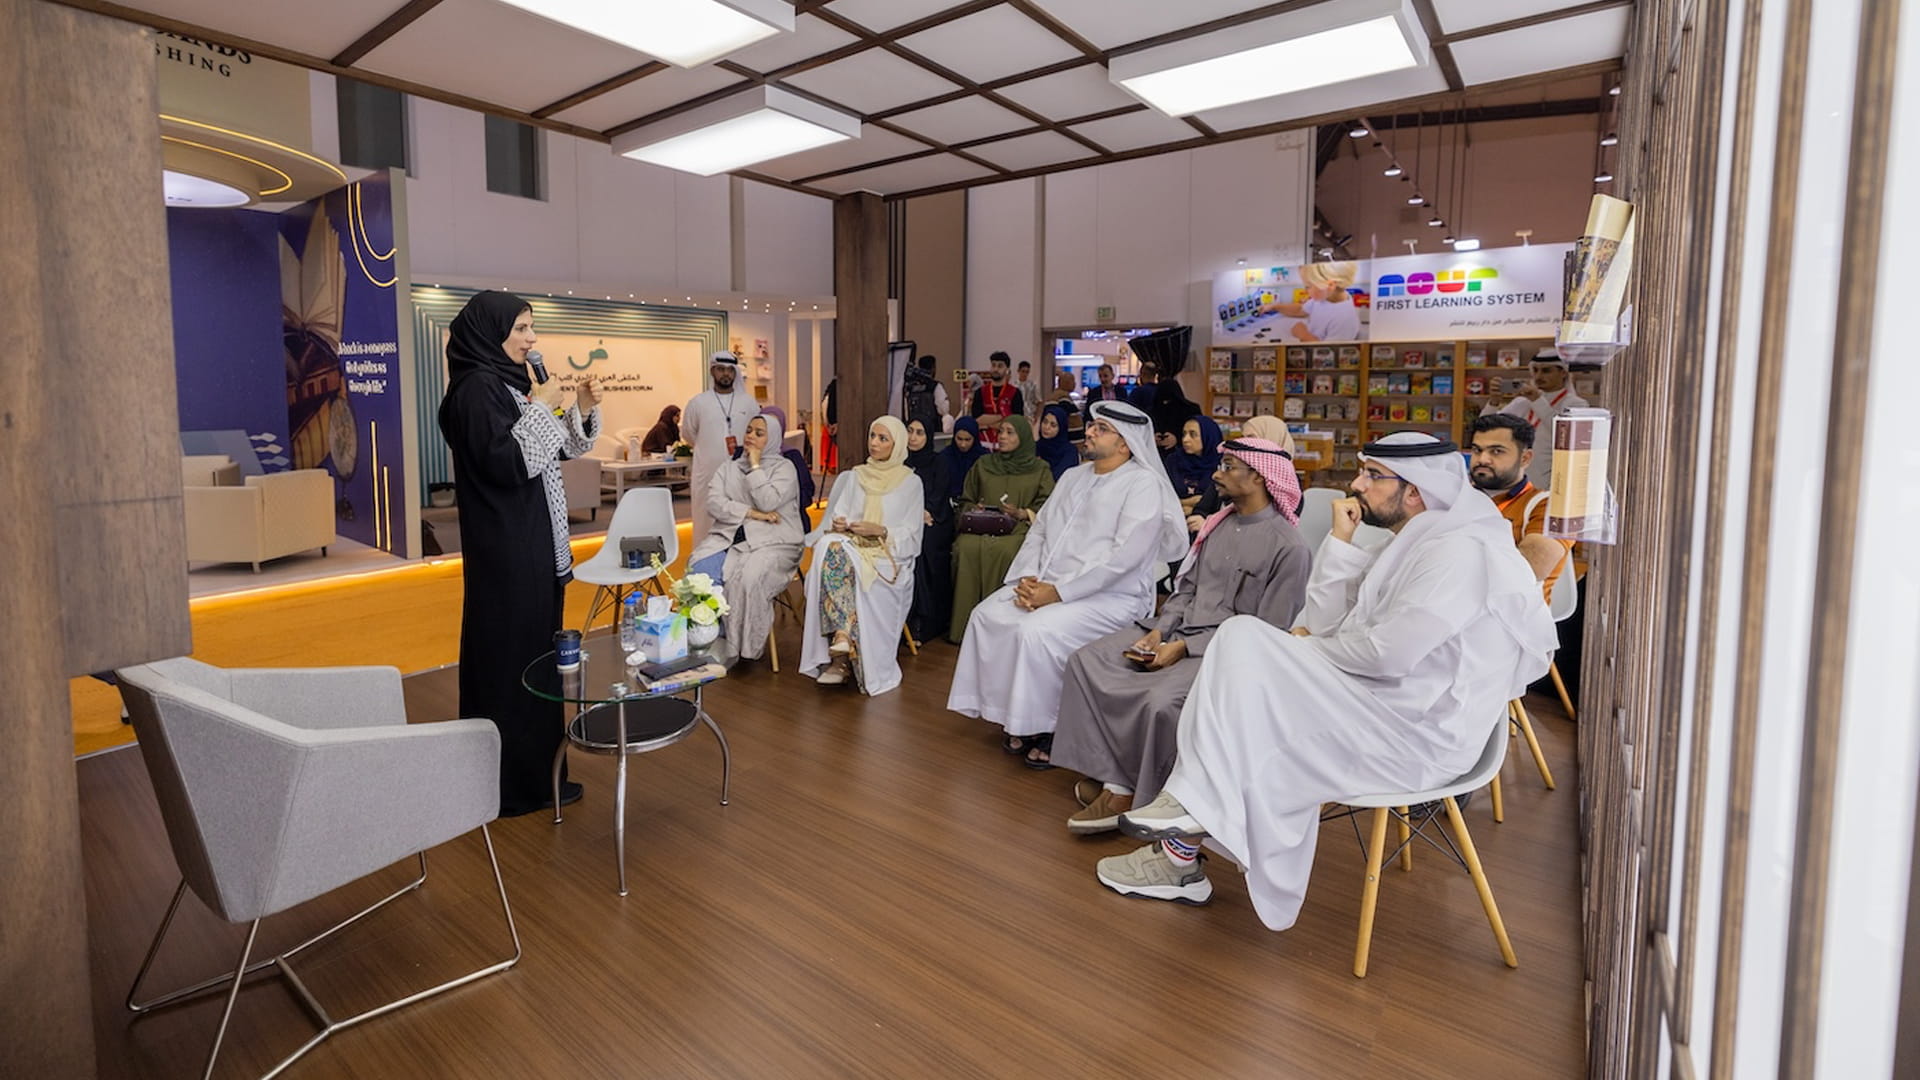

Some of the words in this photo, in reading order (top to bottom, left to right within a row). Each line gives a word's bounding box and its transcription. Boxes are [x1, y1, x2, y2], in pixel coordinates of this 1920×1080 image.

[1376, 300, 1411, 311] FIRST
[1415, 296, 1483, 309] LEARNING
[1487, 293, 1545, 305] SYSTEM
